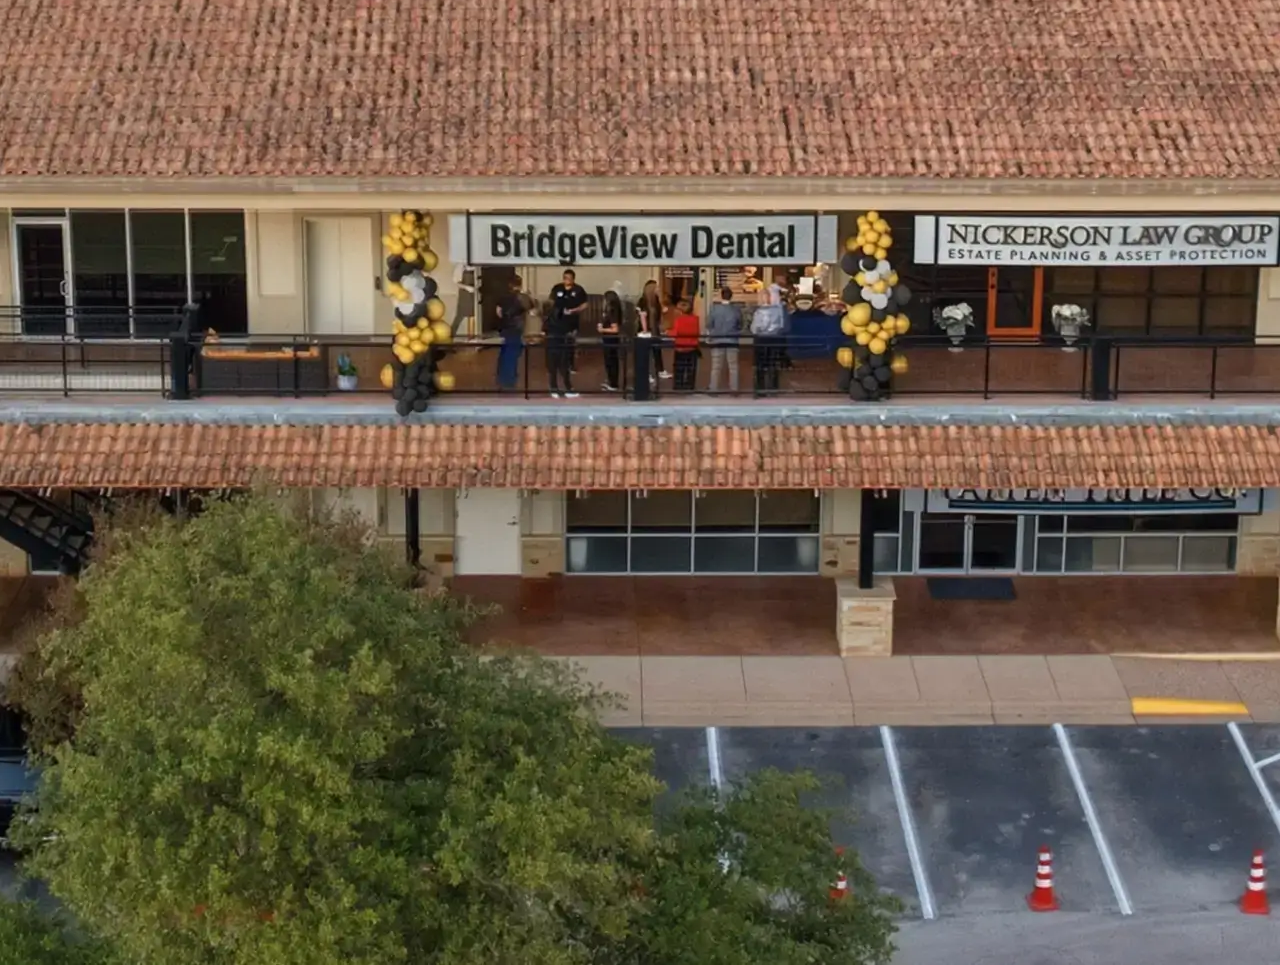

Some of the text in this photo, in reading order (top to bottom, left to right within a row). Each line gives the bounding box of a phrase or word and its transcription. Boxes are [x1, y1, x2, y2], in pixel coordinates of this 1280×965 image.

[490, 224, 795, 265] BridgeView Dental
[946, 223, 1274, 249] NICKERSON LAW GROUP
[947, 248, 1268, 262] ESTATE PLANNING & ASSET PROTECTION
